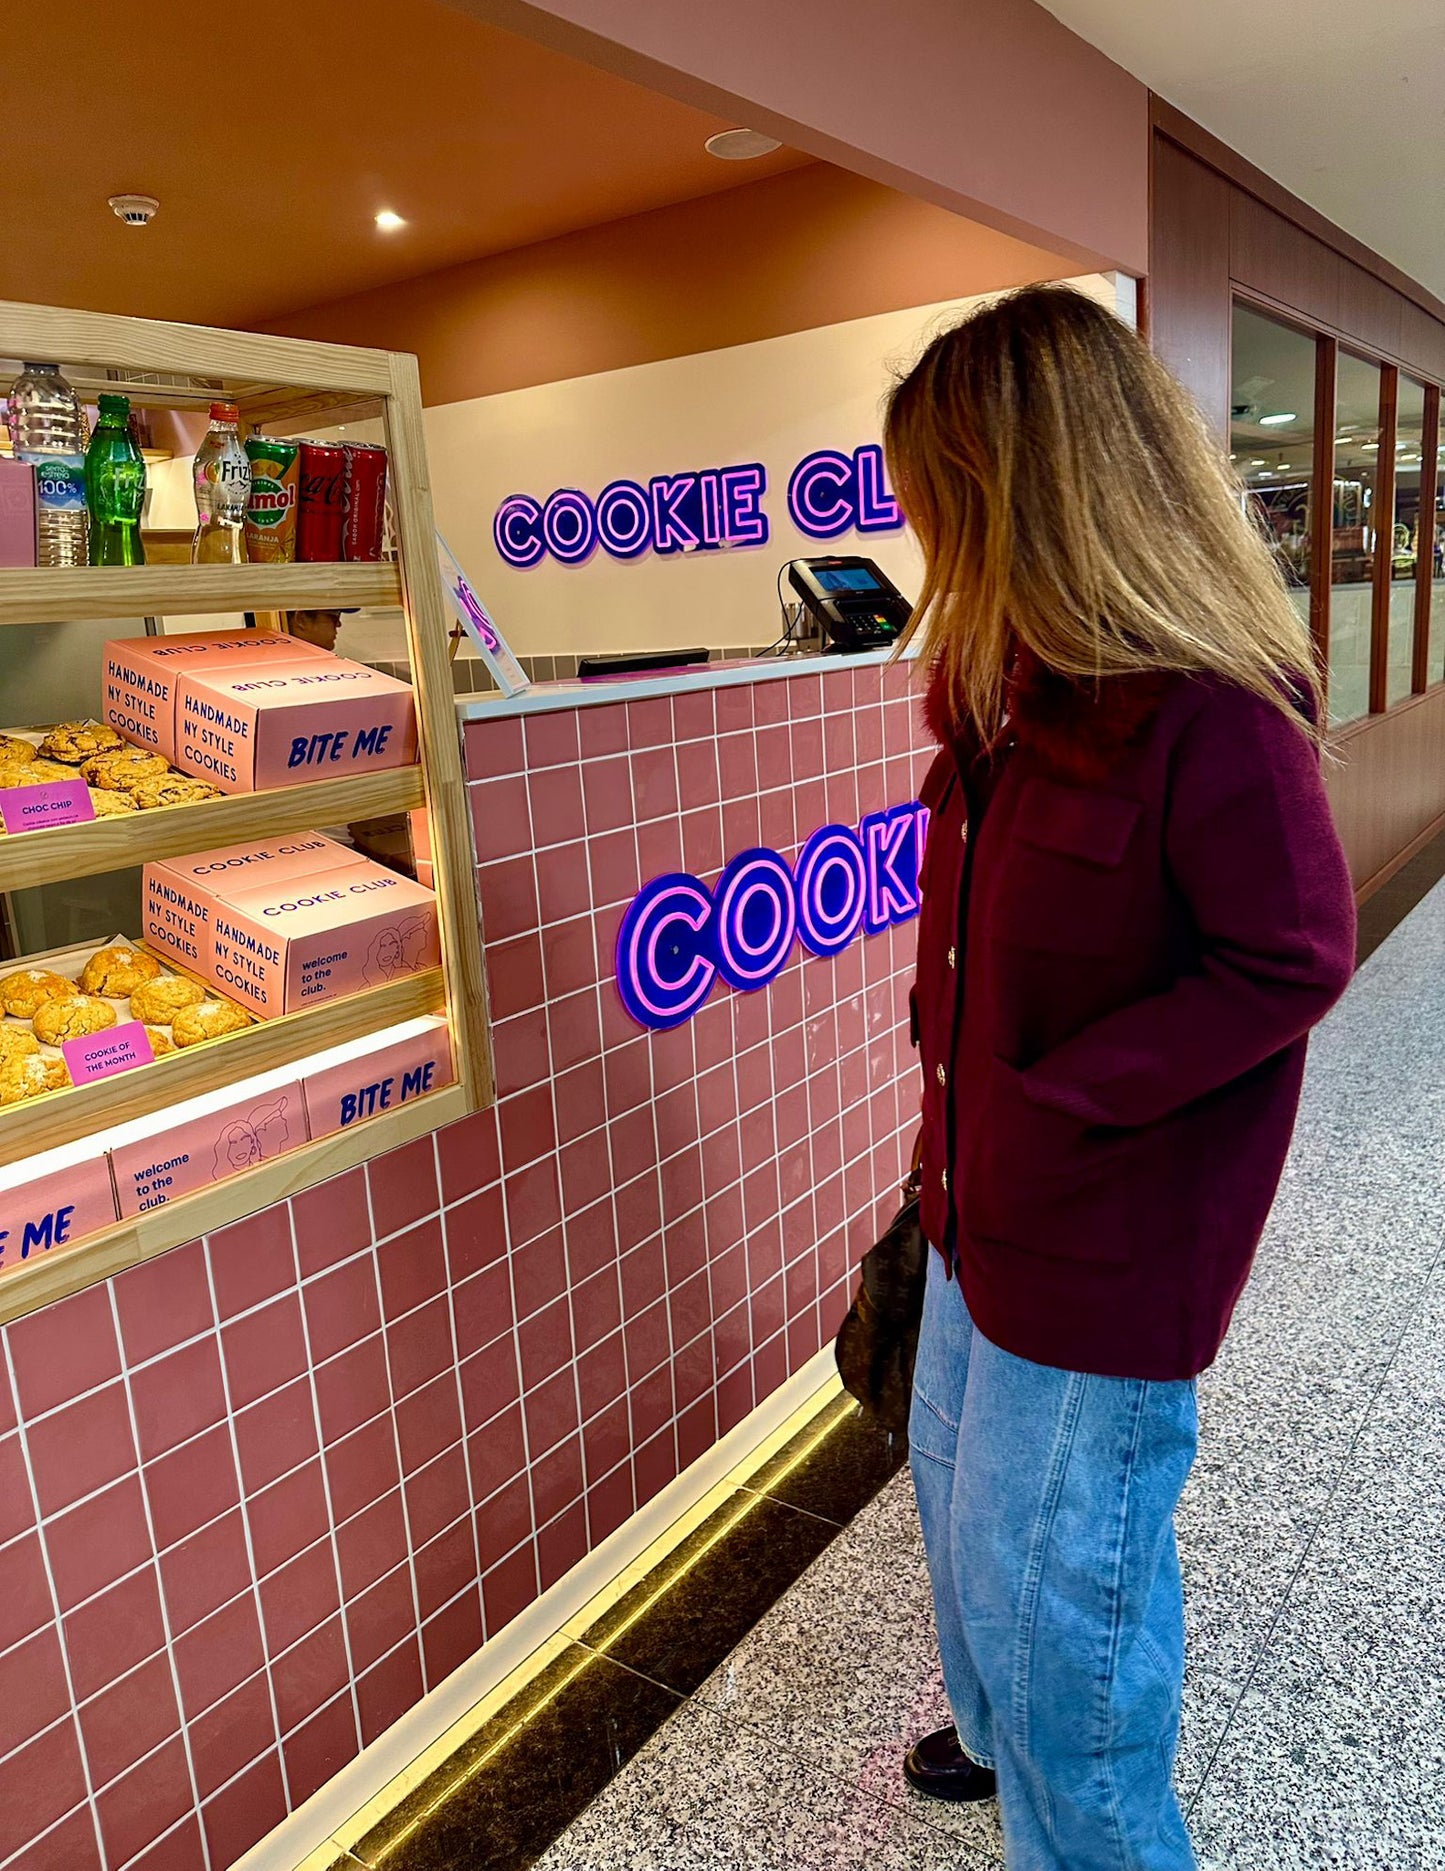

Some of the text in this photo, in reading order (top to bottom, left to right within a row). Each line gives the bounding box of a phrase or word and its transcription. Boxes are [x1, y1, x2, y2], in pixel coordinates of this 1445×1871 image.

[38, 480, 77, 495] 100%
[494, 465, 766, 565] COOKIE
[789, 446, 903, 536] CL
[153, 637, 292, 656] COOKIE CLUB
[108, 660, 169, 702] HANDMADE
[232, 672, 372, 692] COOKIE CLUB
[108, 685, 155, 720] NY STYLE
[185, 694, 249, 739] HANDMADE
[108, 709, 159, 745] COOKIES
[184, 719, 234, 758] NY STYLE
[184, 744, 237, 782] COOKIES
[287, 725, 393, 769] BITE ME
[22, 800, 72, 815] CHOC CHIP
[193, 840, 326, 876] COOKIE CLUB
[149, 877, 209, 922] HANDMADE
[263, 878, 398, 917] COOKIE CLUB
[149, 898, 196, 938] NY STYLE
[149, 921, 198, 960] COOKIES
[216, 918, 280, 966] HANDMADE
[215, 941, 265, 982] NY STYLE
[301, 968, 331, 985] to the
[302, 950, 348, 971] welcome
[215, 964, 267, 1004] COOKIES
[301, 982, 326, 997] club.
[84, 1041, 130, 1062] COOKIE OF
[85, 1052, 136, 1073] THE MONTH
[340, 1061, 436, 1127] BITE ME
[134, 1154, 190, 1182] welcome
[136, 1176, 173, 1197] to the
[139, 1194, 170, 1211] club.
[21, 1205, 75, 1259] ME
